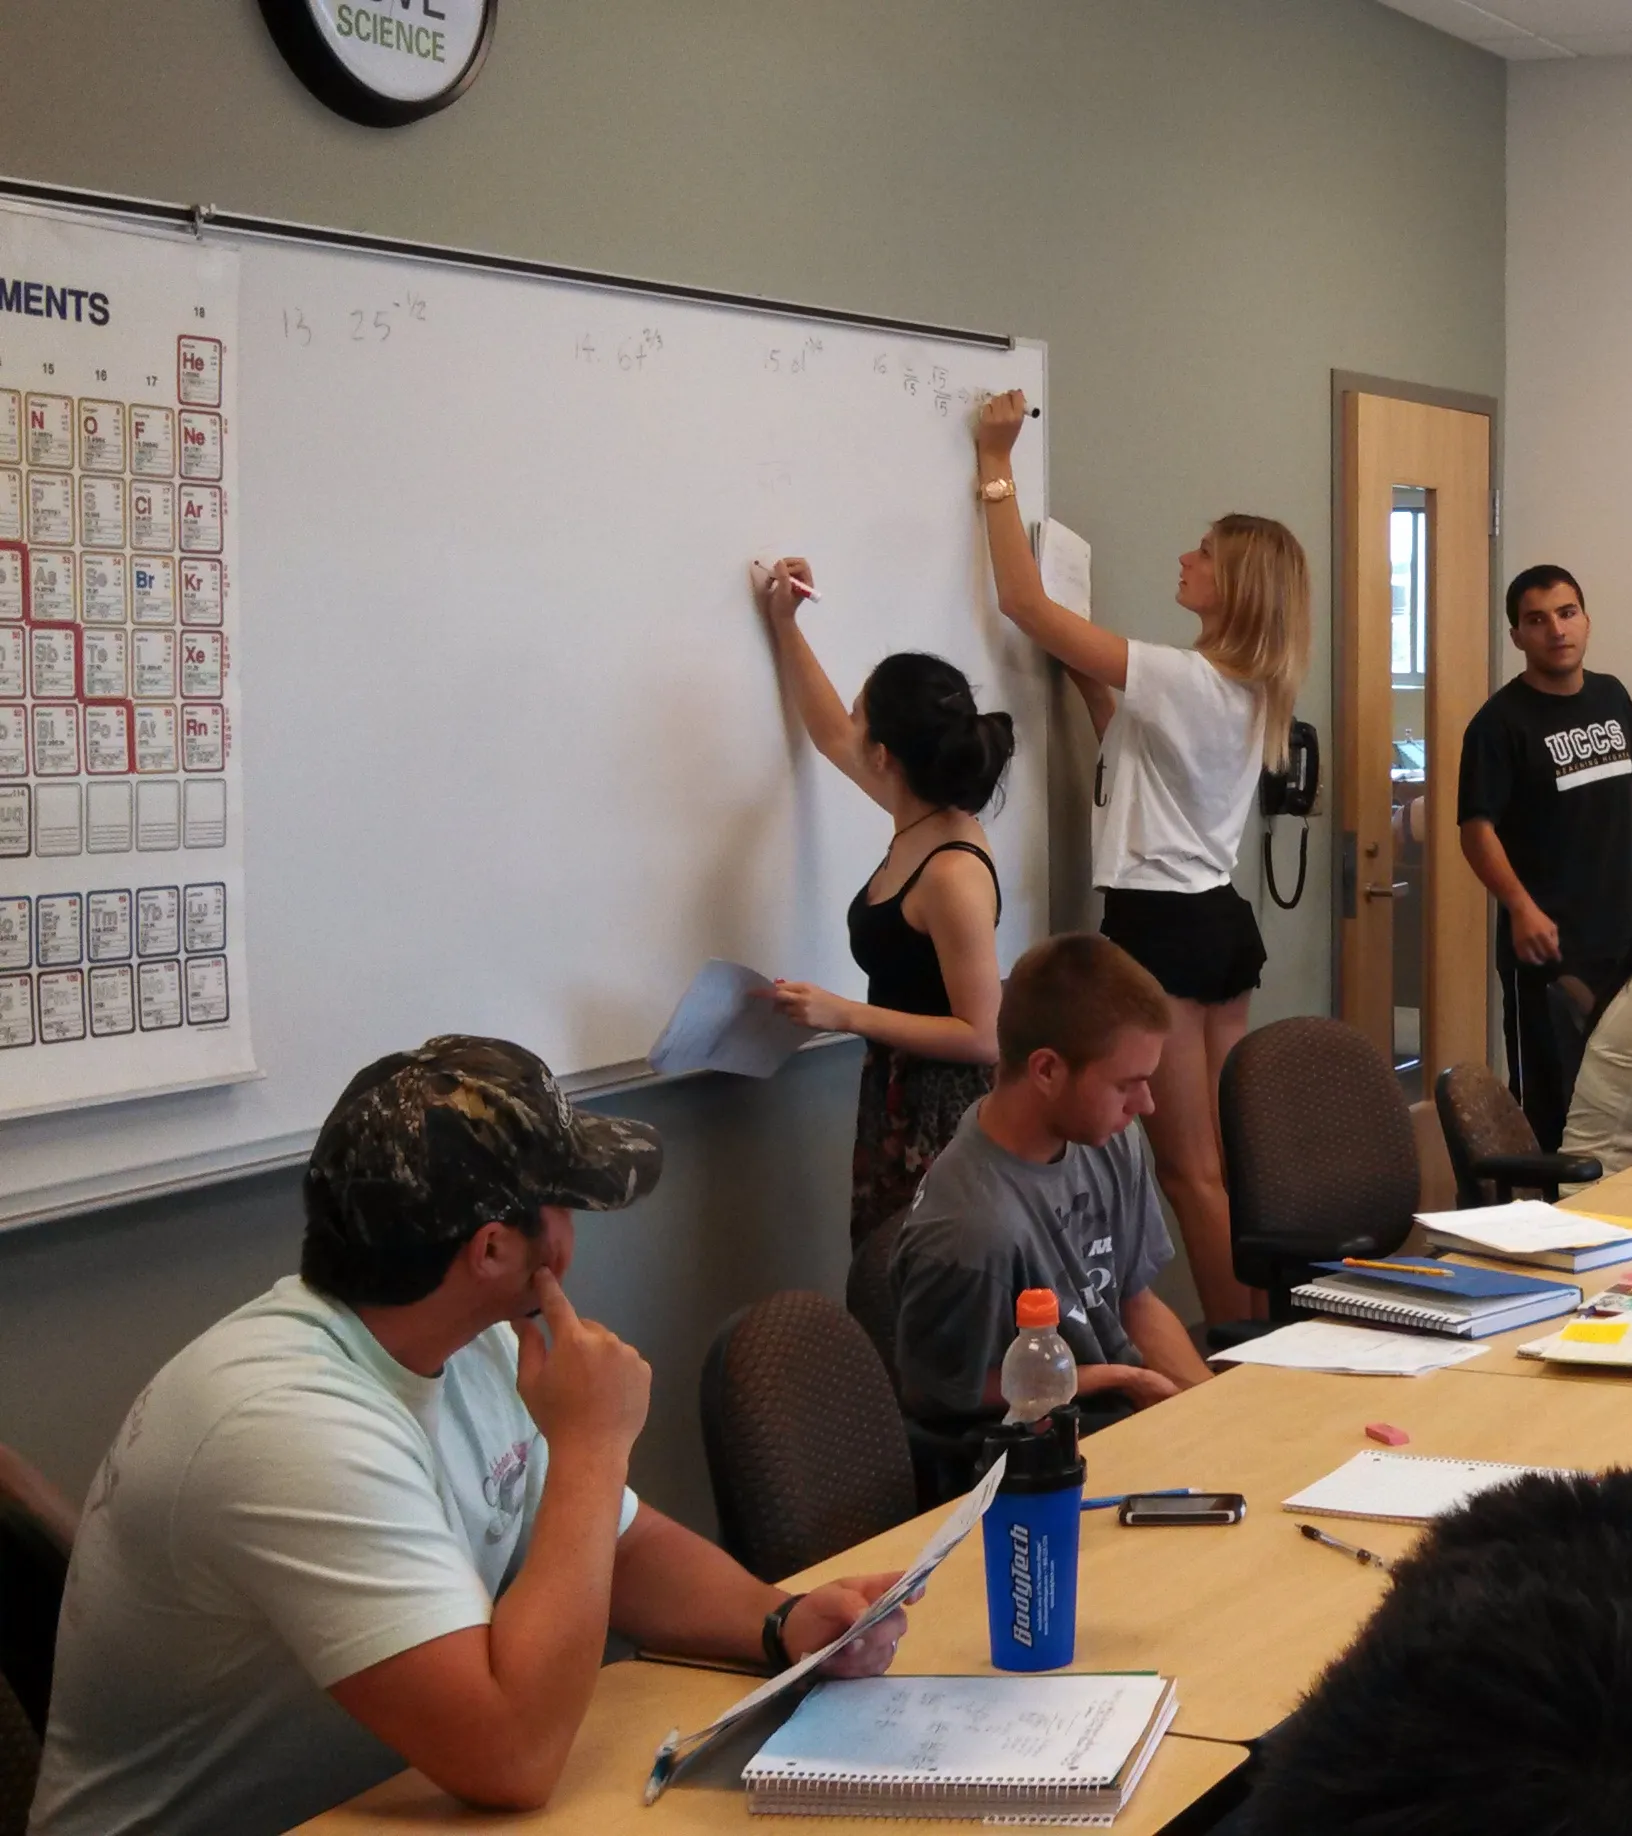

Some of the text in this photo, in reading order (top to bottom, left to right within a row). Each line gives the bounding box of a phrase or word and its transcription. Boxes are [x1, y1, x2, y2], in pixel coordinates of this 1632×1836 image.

[337, 4, 445, 63] SCIENCE
[0, 277, 110, 327] MENTS
[193, 306, 205, 318] 18
[182, 351, 205, 371] He
[43, 362, 158, 387] 15 16 17
[31, 410, 44, 430] N
[83, 415, 98, 435] O
[135, 421, 146, 440] F
[184, 426, 206, 446] Ne
[184, 499, 204, 519] Ar
[136, 570, 156, 590] Br
[184, 572, 204, 592] Kr
[184, 645, 206, 664] Xe
[185, 718, 209, 737] Rn
[1544, 719, 1626, 766] UCCS
[1009, 1523, 1033, 1648] BodyTech
